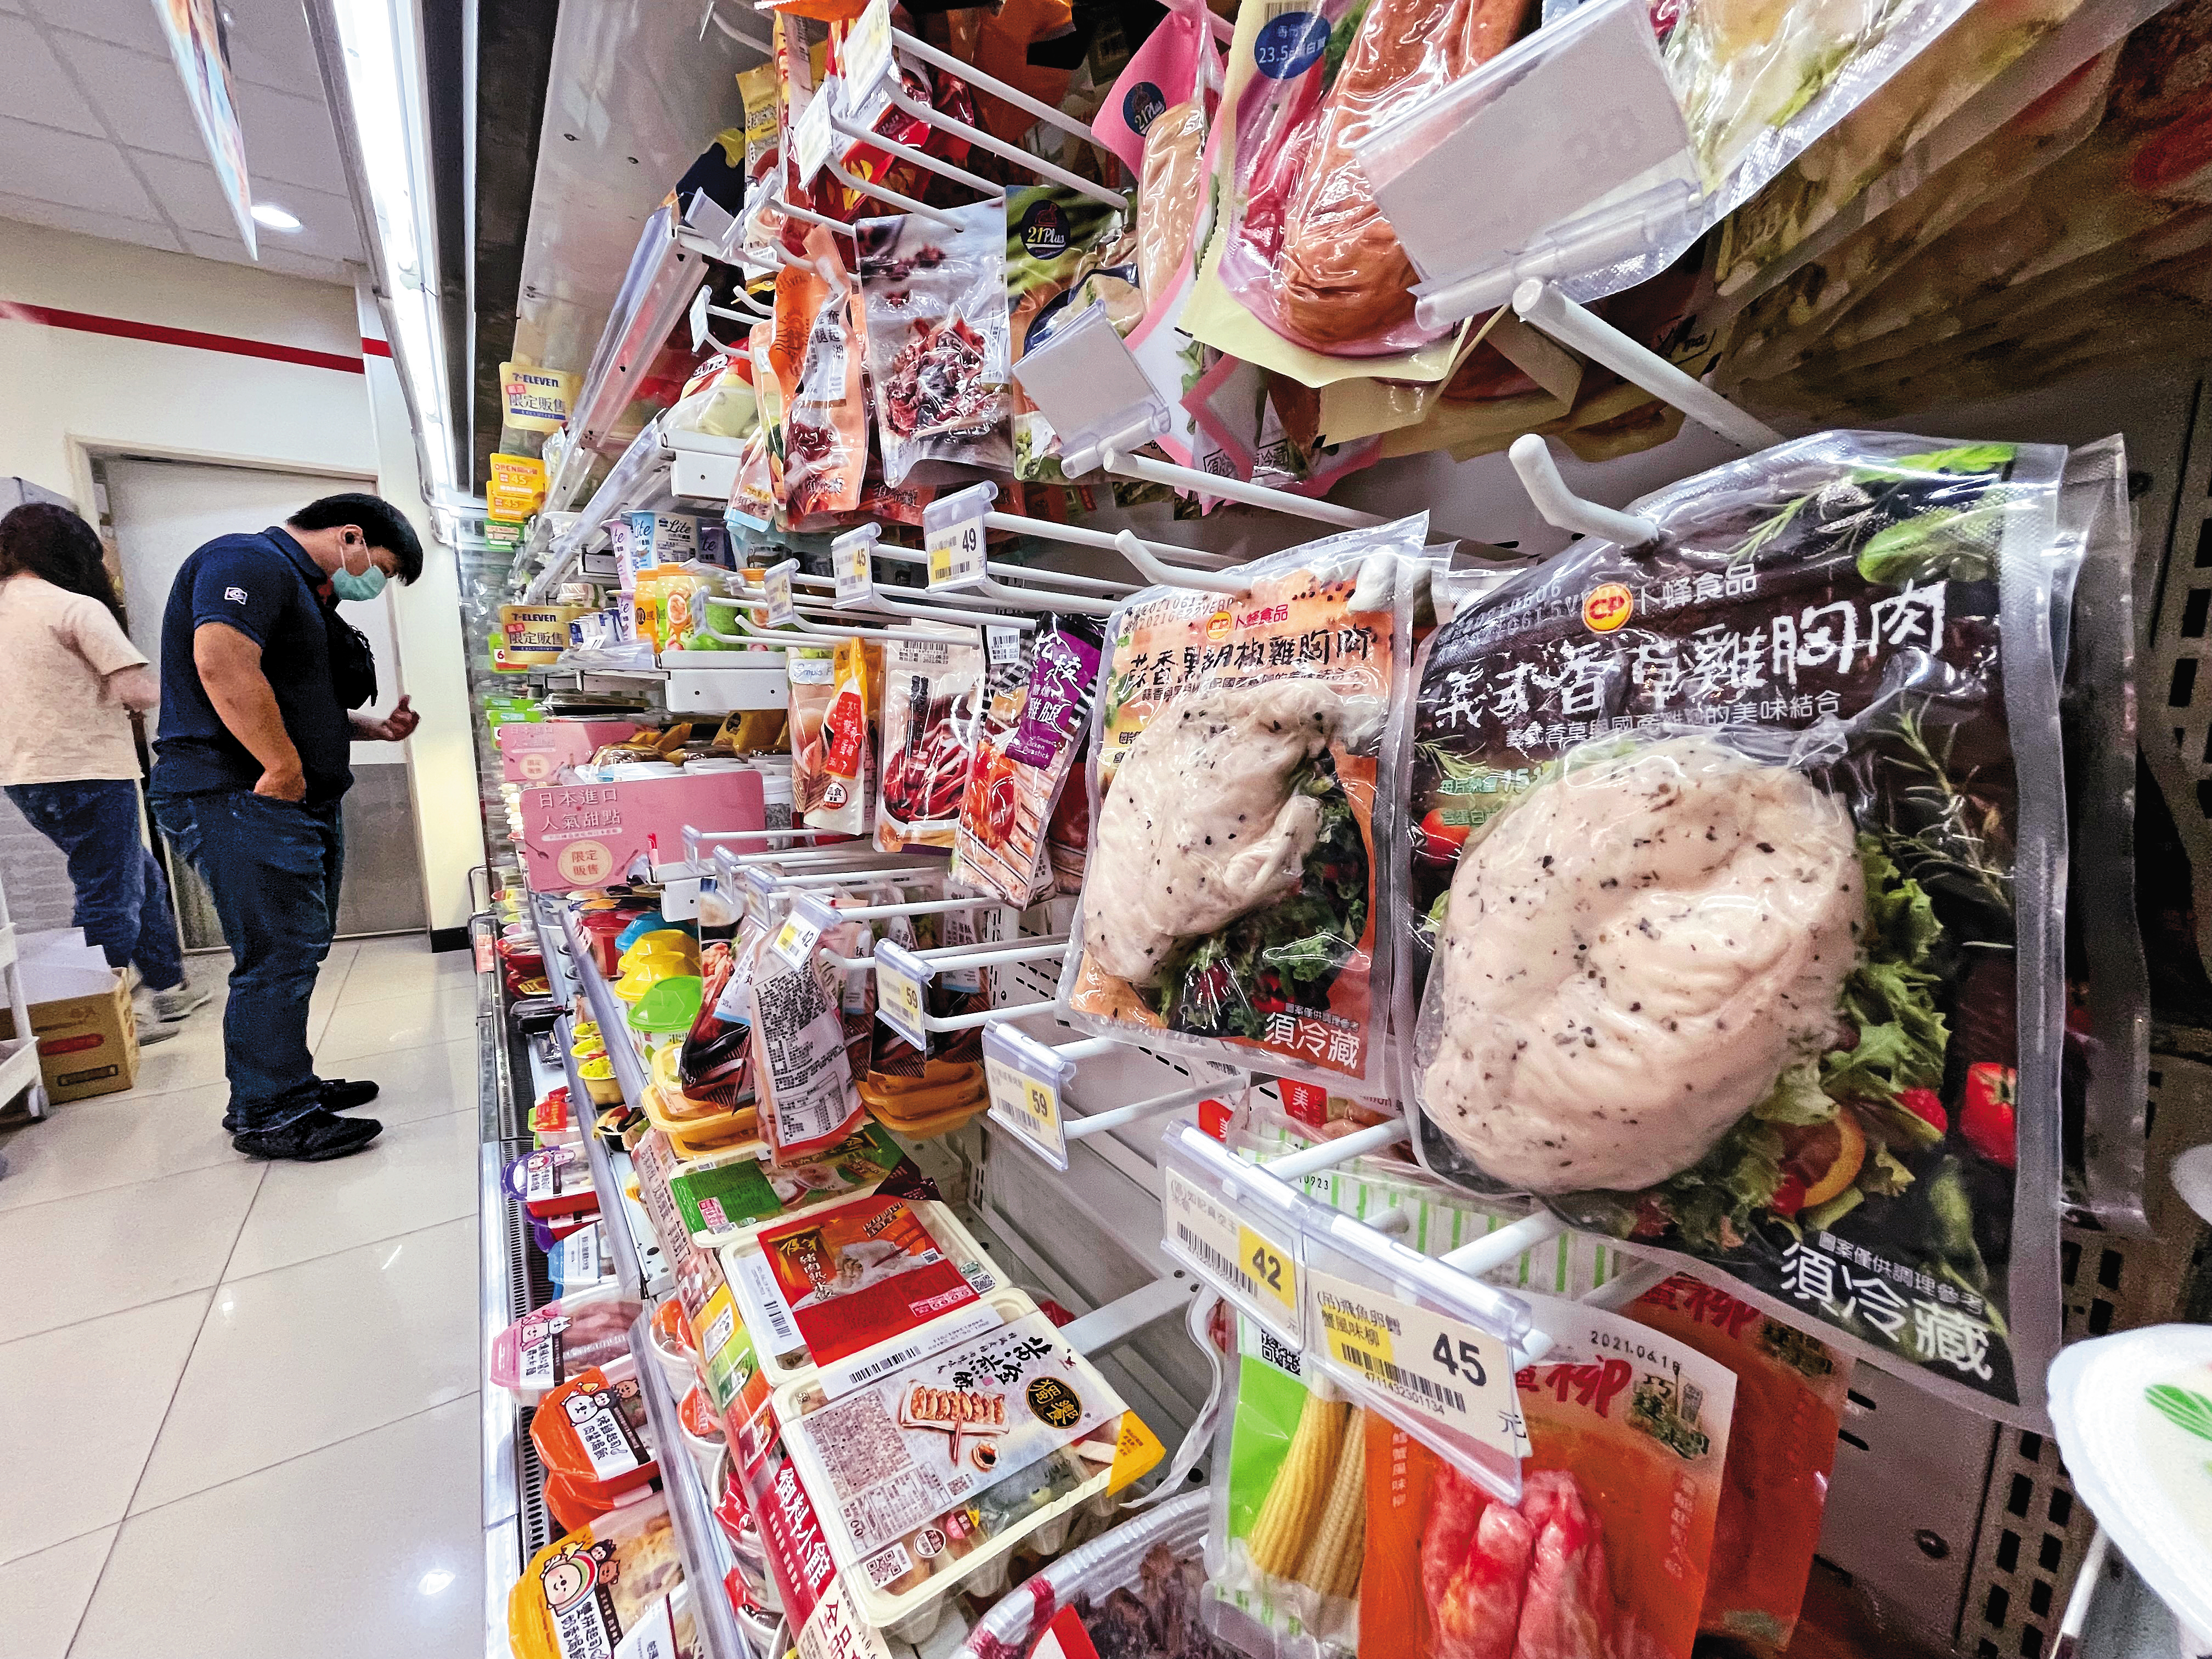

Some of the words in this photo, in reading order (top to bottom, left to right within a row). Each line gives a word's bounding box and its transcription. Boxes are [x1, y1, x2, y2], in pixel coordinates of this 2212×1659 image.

[1027, 225, 1064, 244] 21Plus
[512, 373, 559, 388] 7-ELEVEN
[509, 393, 566, 413] 限定販售
[667, 516, 691, 534] Lite
[963, 527, 977, 553] 49
[856, 548, 866, 567] 45
[1640, 563, 1757, 616] 卜蜂食品
[512, 612, 557, 622] 7-ELEVEN
[1589, 594, 1625, 620] CP
[509, 631, 563, 646] 限定販售
[539, 788, 618, 809] 日本進口
[540, 809, 622, 833] 人氣甜點
[571, 849, 599, 862] 限定
[573, 863, 599, 877] 販售
[802, 930, 814, 948] 42
[905, 986, 919, 1009] 59
[1263, 1012, 1361, 1070] 須冷藏
[1031, 1088, 1048, 1118] 59
[1252, 1246, 1282, 1292] 42
[1818, 1231, 1987, 1315] 圖案僅供調理參考
[1780, 1242, 1994, 1381] 須冷藏
[1432, 1331, 1487, 1387] 45
[1498, 1409, 1528, 1438] 元
